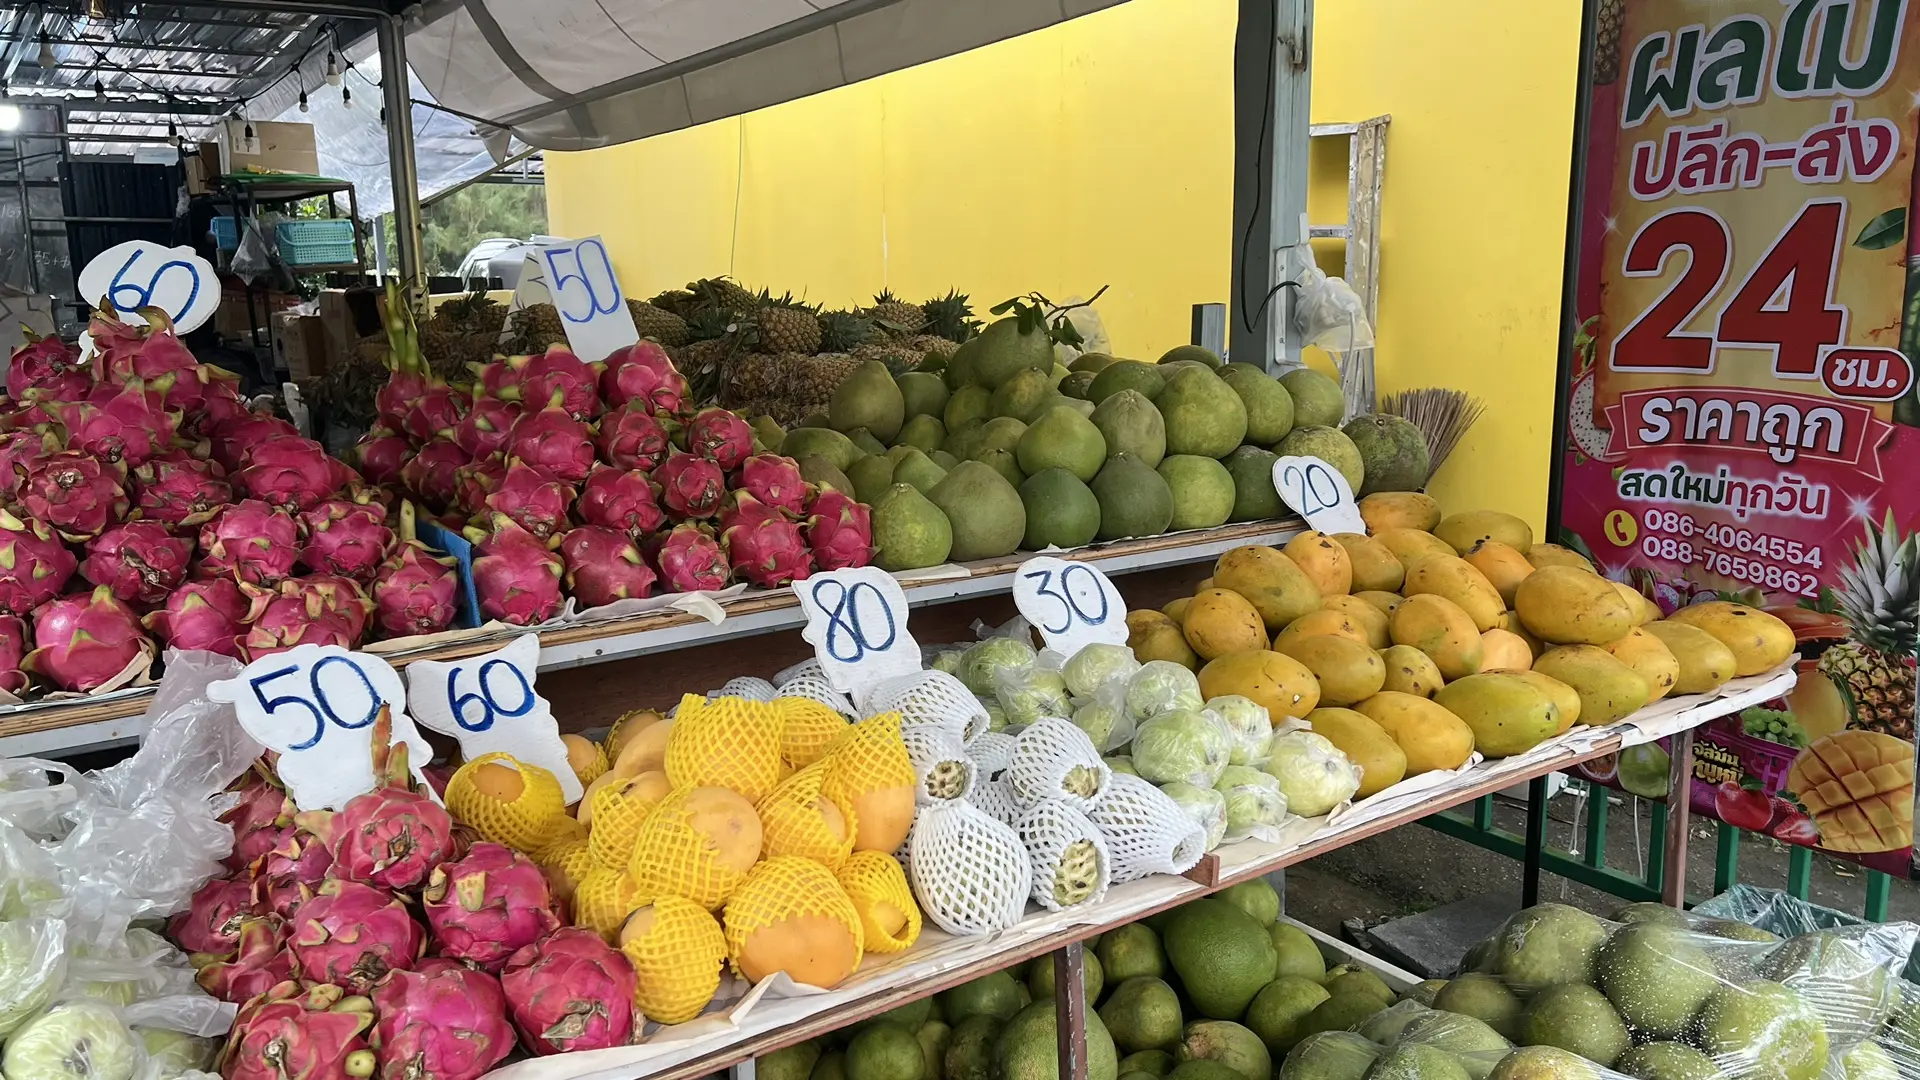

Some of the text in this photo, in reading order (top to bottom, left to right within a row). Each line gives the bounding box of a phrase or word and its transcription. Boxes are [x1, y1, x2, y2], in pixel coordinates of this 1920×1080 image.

[1622, 0, 1903, 127] ผลไม
[1632, 104, 1895, 197] ปลีก-ส่ง
[108, 248, 200, 325] 60
[544, 239, 620, 323] 50
[1611, 200, 1897, 389] 24 ชม.
[1637, 397, 1844, 463] ราคาถูก
[1284, 463, 1341, 516] 20
[1620, 464, 1826, 520] สดใหม่ทุกวัน
[1642, 536, 1819, 598] 088-7659862
[1643, 510, 1823, 569] 086-4064554
[811, 578, 896, 664] 80
[1023, 564, 1108, 635] 30
[249, 655, 385, 751] 50
[447, 658, 535, 733] 60
